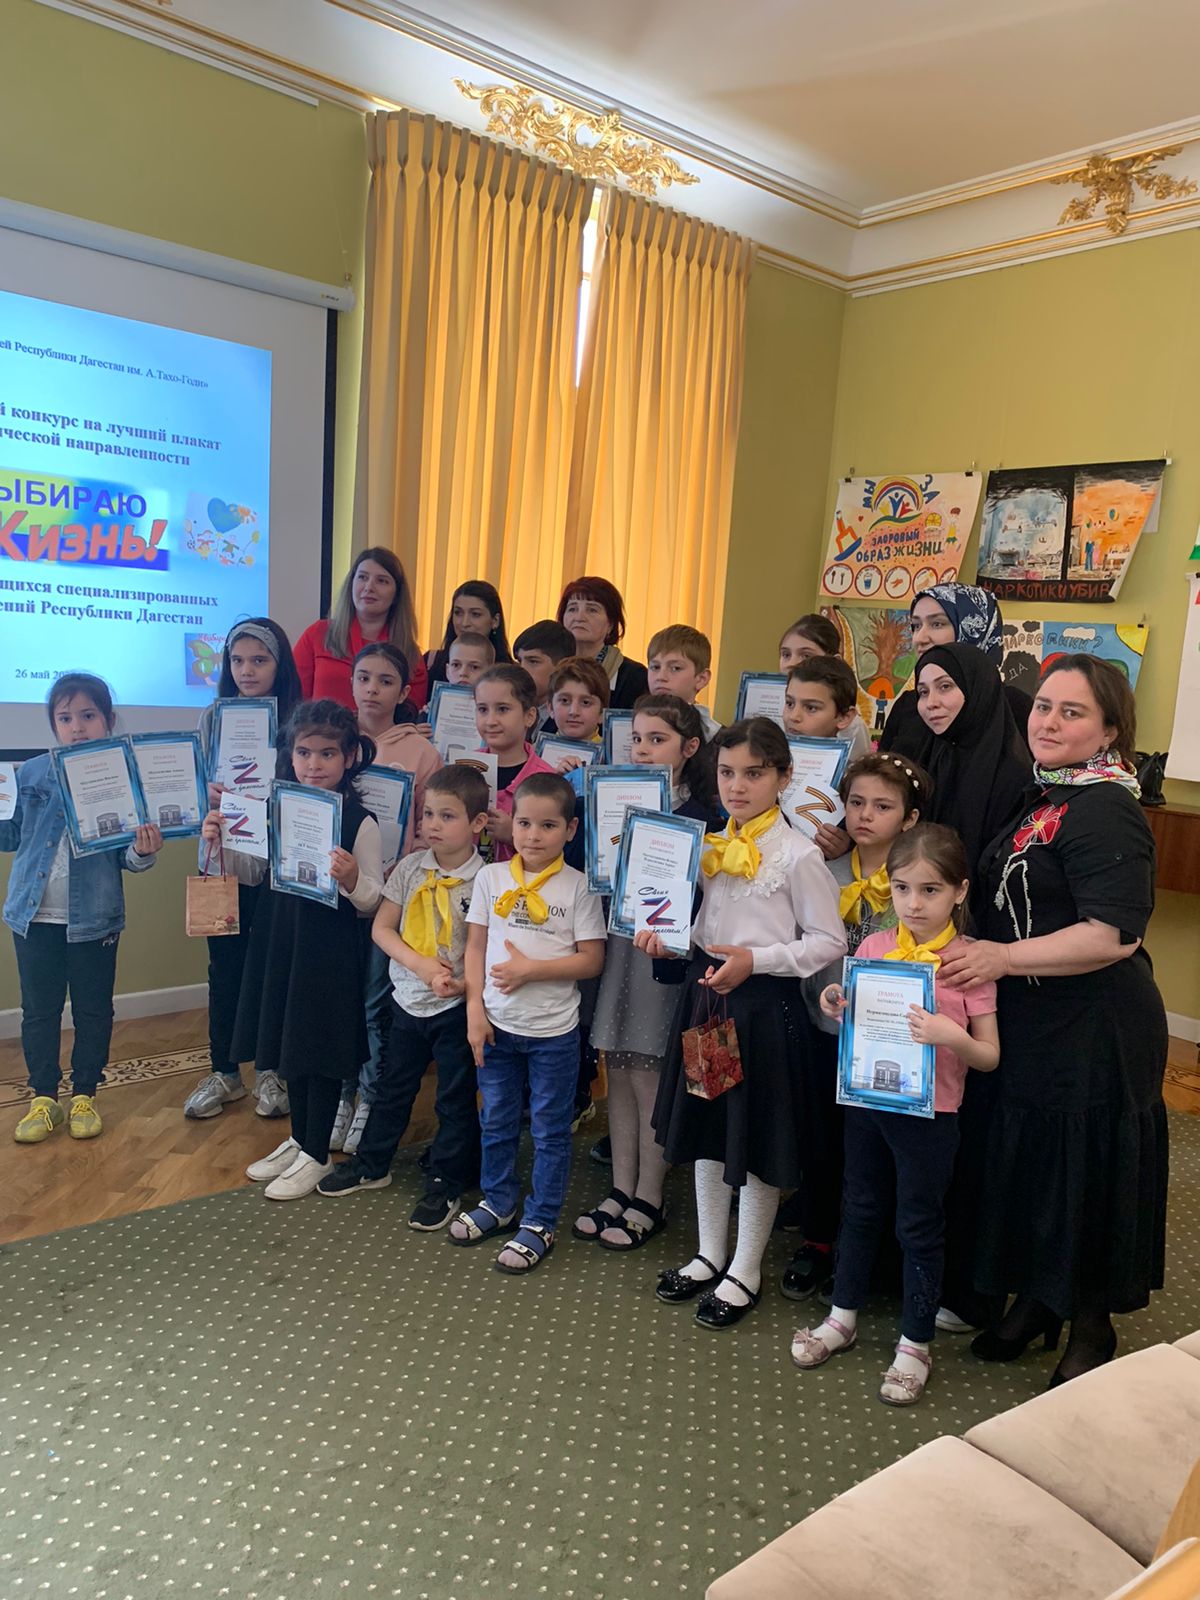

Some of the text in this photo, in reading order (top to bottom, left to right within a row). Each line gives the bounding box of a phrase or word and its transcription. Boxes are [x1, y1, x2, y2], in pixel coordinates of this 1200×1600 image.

[14, 341, 77, 363] Республики
[79, 353, 125, 372] Дагестан
[127, 365, 143, 376] им.
[11, 406, 79, 429] конкурс
[84, 419, 102, 432] на
[105, 422, 167, 442] лучший
[171, 434, 222, 451] плакат
[66, 437, 190, 466] направленности
[871, 528, 920, 547] ЗДОРОВЫЙ
[856, 546, 891, 563] ОБРАЗ
[56, 583, 218, 607] специализированных
[41, 600, 133, 620] Республики
[136, 608, 204, 625] Дагестан
[15, 668, 28, 678] 26
[31, 670, 50, 680] май
[1009, 662, 1029, 681] ДА
